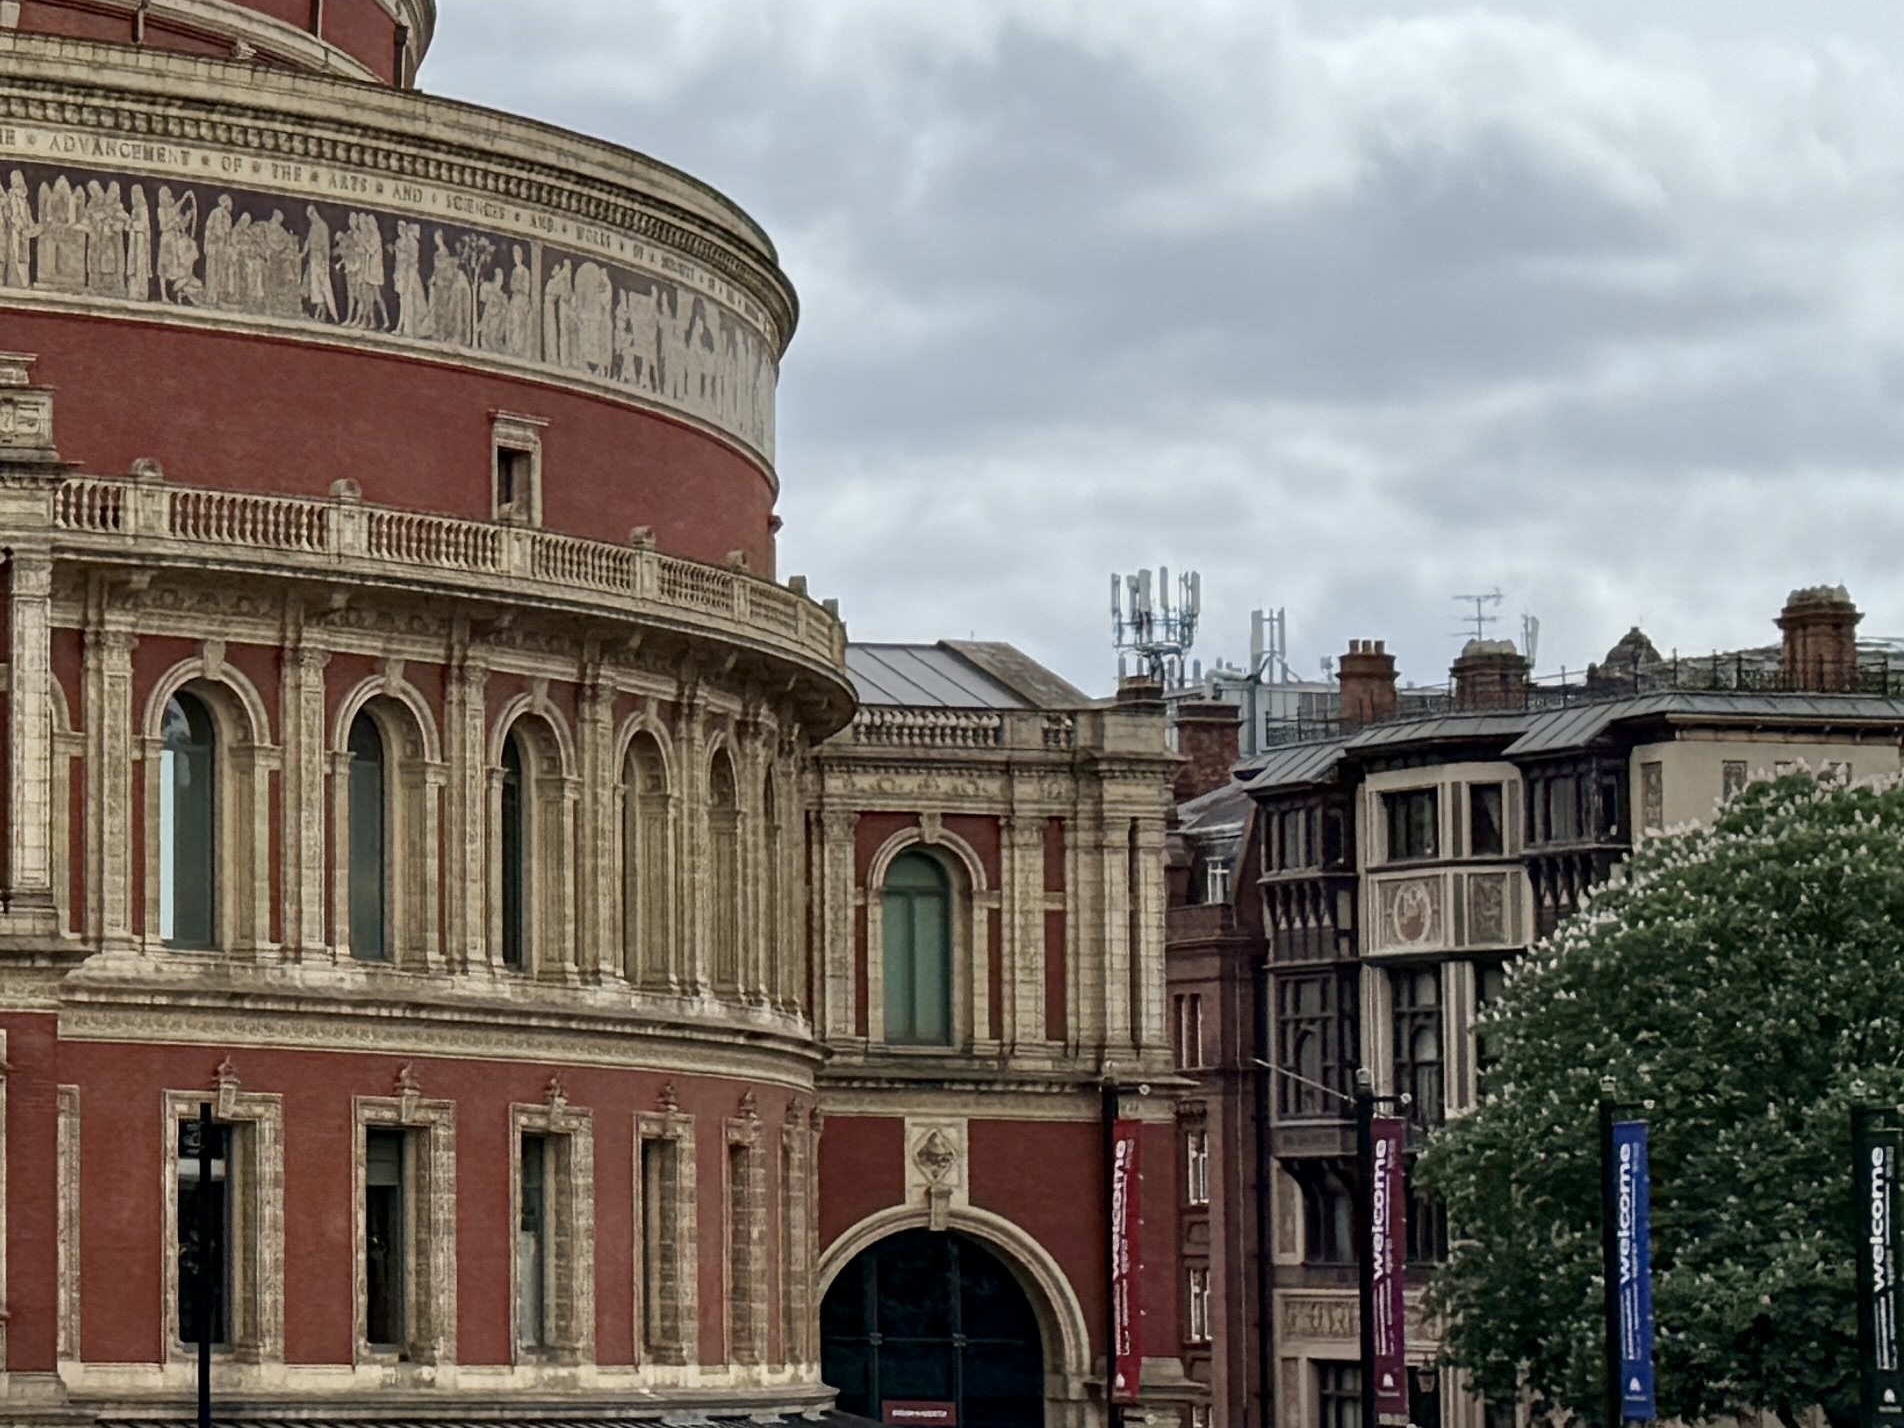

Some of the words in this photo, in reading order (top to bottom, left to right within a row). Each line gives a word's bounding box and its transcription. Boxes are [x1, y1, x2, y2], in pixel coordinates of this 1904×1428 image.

[49, 134, 191, 167] ADVANCEMENT
[221, 154, 243, 174] OF
[271, 161, 303, 183] THE
[328, 171, 368, 195] ARTS
[392, 183, 423, 205] AND
[1372, 1139, 1386, 1280] welcome
[1617, 1143, 1632, 1285] welcome
[1870, 1146, 1884, 1293] welcome
